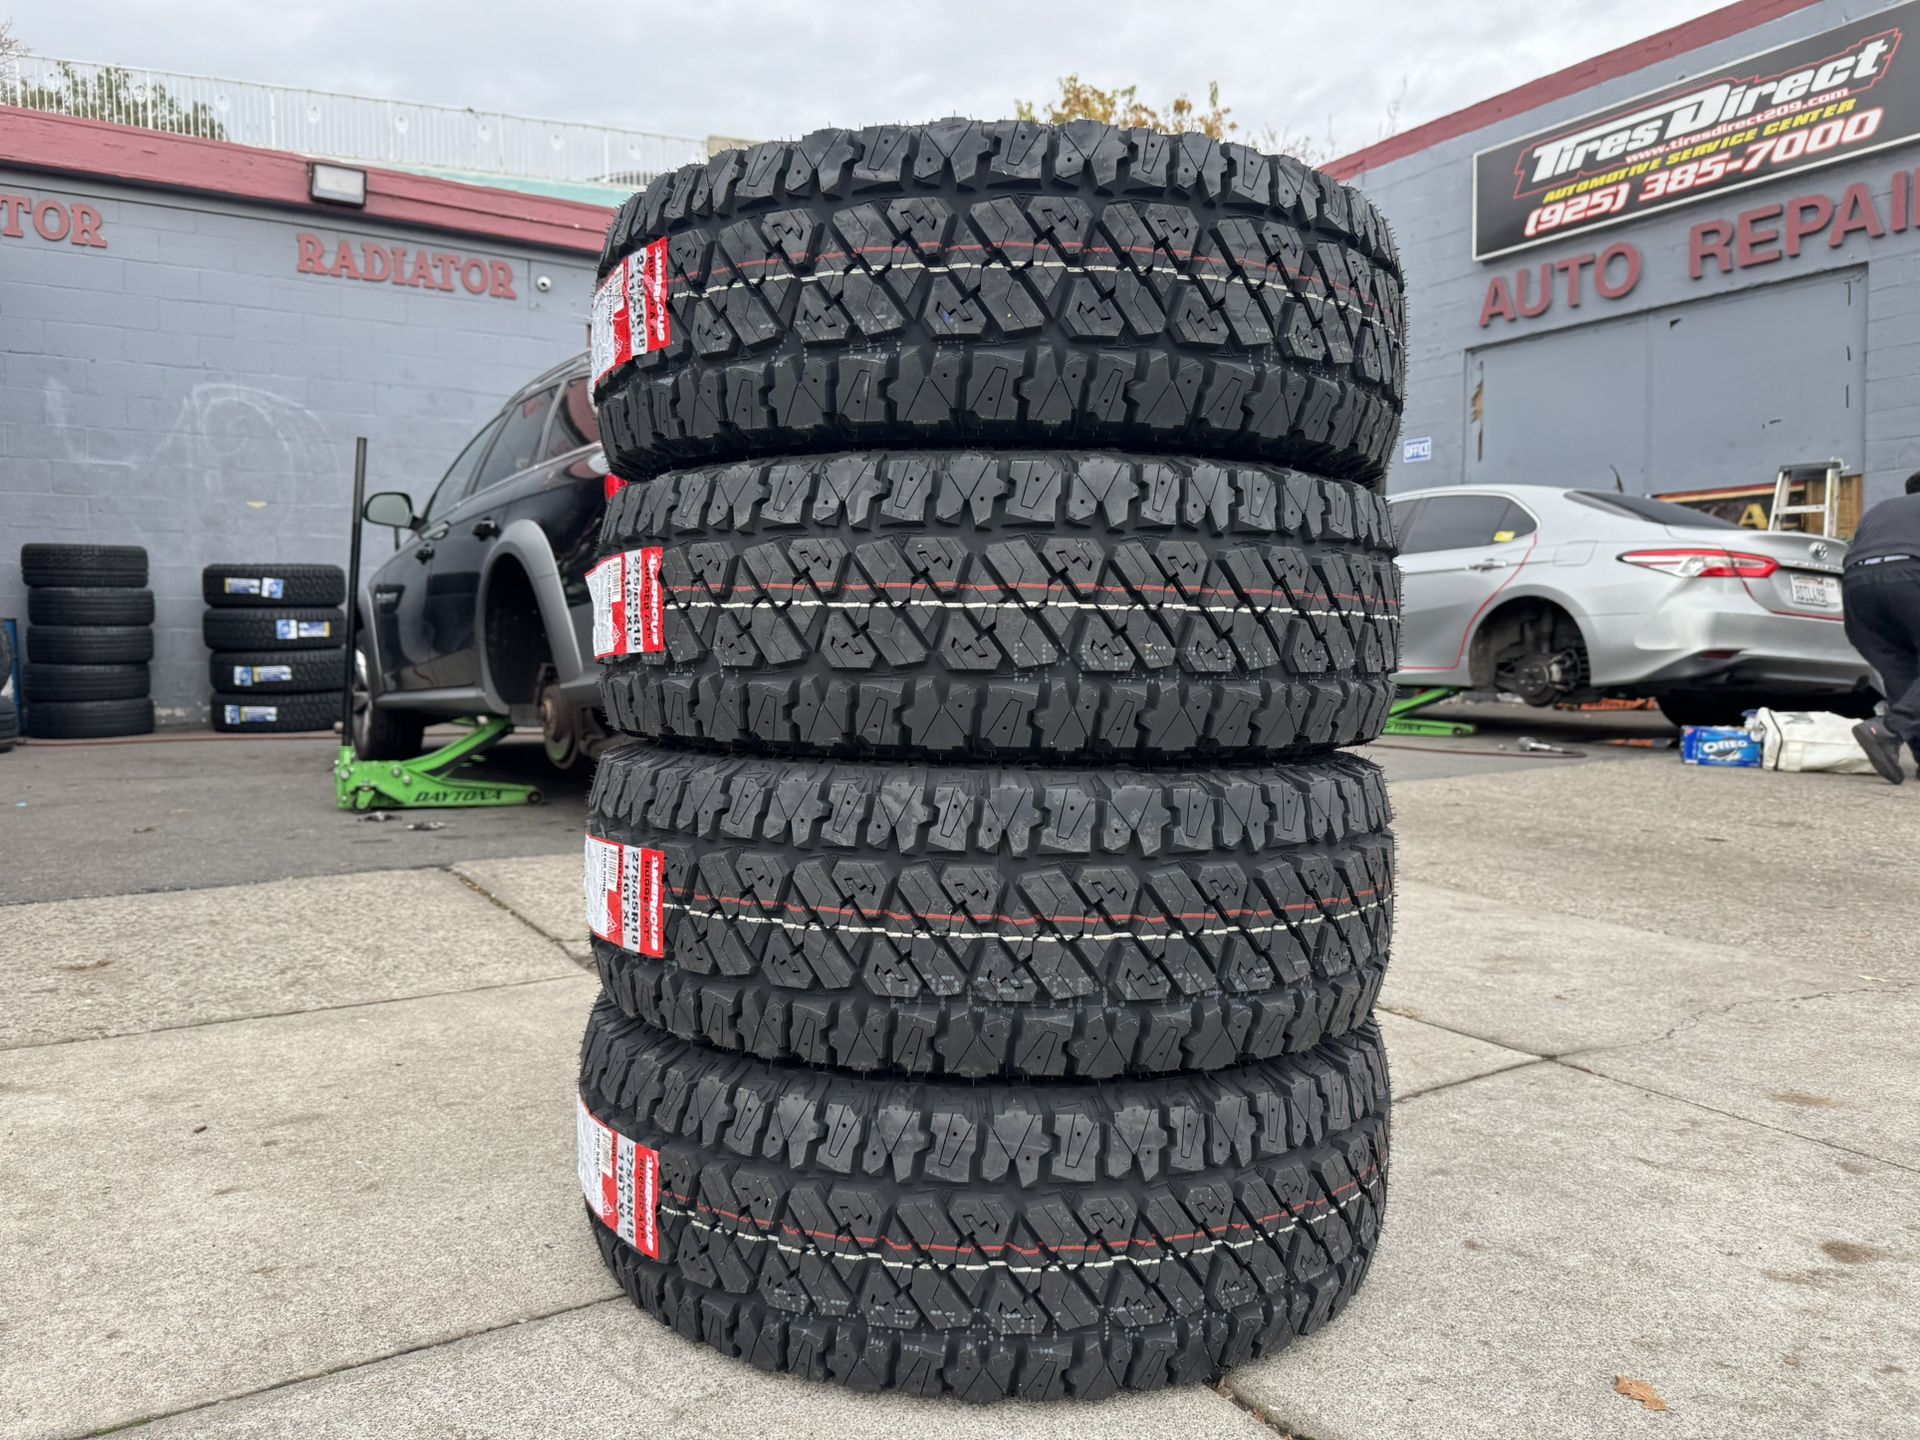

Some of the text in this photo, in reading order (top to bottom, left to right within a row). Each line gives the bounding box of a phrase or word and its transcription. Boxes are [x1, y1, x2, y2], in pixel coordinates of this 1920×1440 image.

[1531, 38, 1889, 183] Tires Direct
[1542, 98, 1857, 204] AUTOMOTIVE SERVICE CENTER
[1625, 88, 1849, 164] www.tiresdirect209.com
[1524, 106, 1885, 237] (925) 385-7000
[297, 233, 517, 300] RADIATOR
[1478, 166, 1920, 328] AUTO REPAI
[633, 555, 641, 647] 275/65R18
[1703, 739, 1748, 753] OREO
[414, 789, 503, 802] DAYTONA
[622, 910, 630, 932] XL
[631, 852, 640, 945] 275/65R18
[649, 855, 659, 952] AMERICUS
[618, 1198, 626, 1221] XL
[626, 1144, 636, 1240] 275/65R18
[645, 1154, 654, 1252] AMERICUS
